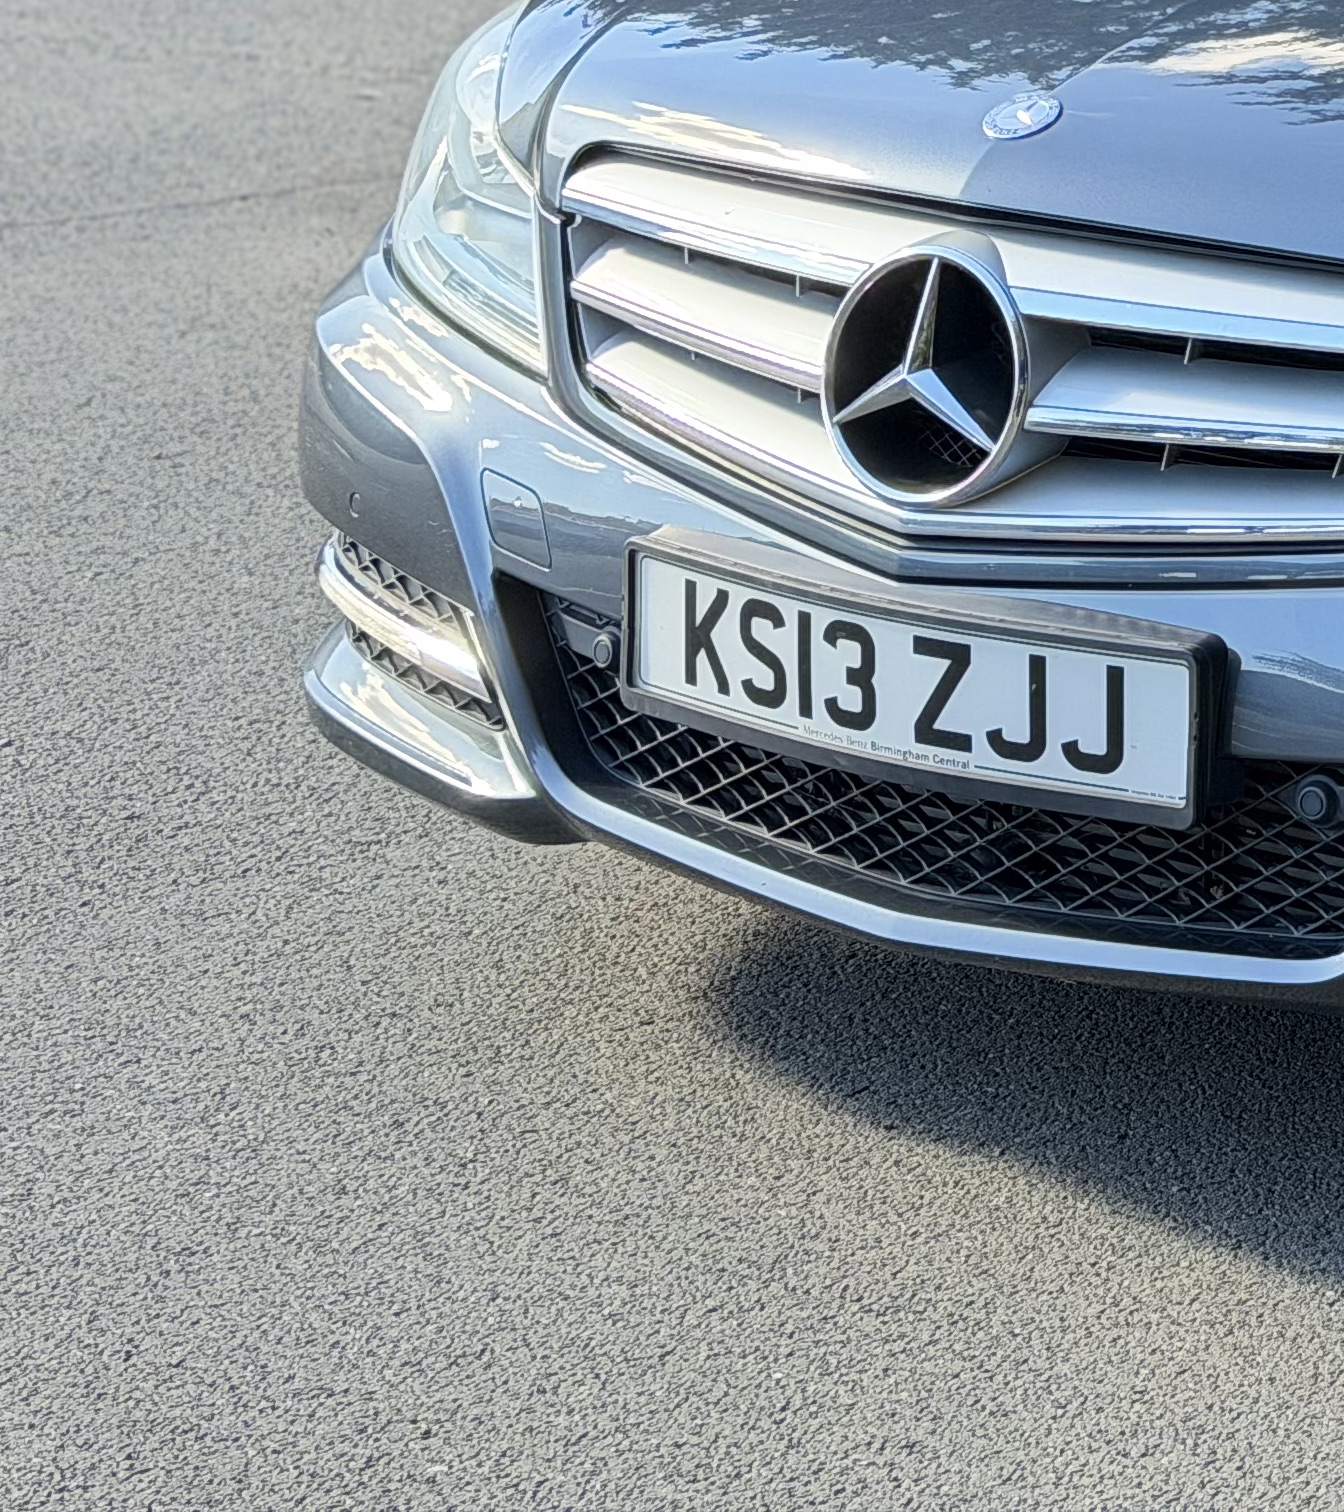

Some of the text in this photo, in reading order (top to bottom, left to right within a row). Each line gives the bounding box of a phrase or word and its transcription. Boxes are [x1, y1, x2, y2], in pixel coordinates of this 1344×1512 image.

[685, 580, 1124, 774] KS13 ZJJ
[870, 740, 929, 761] Birmingham
[932, 753, 970, 769] Central
